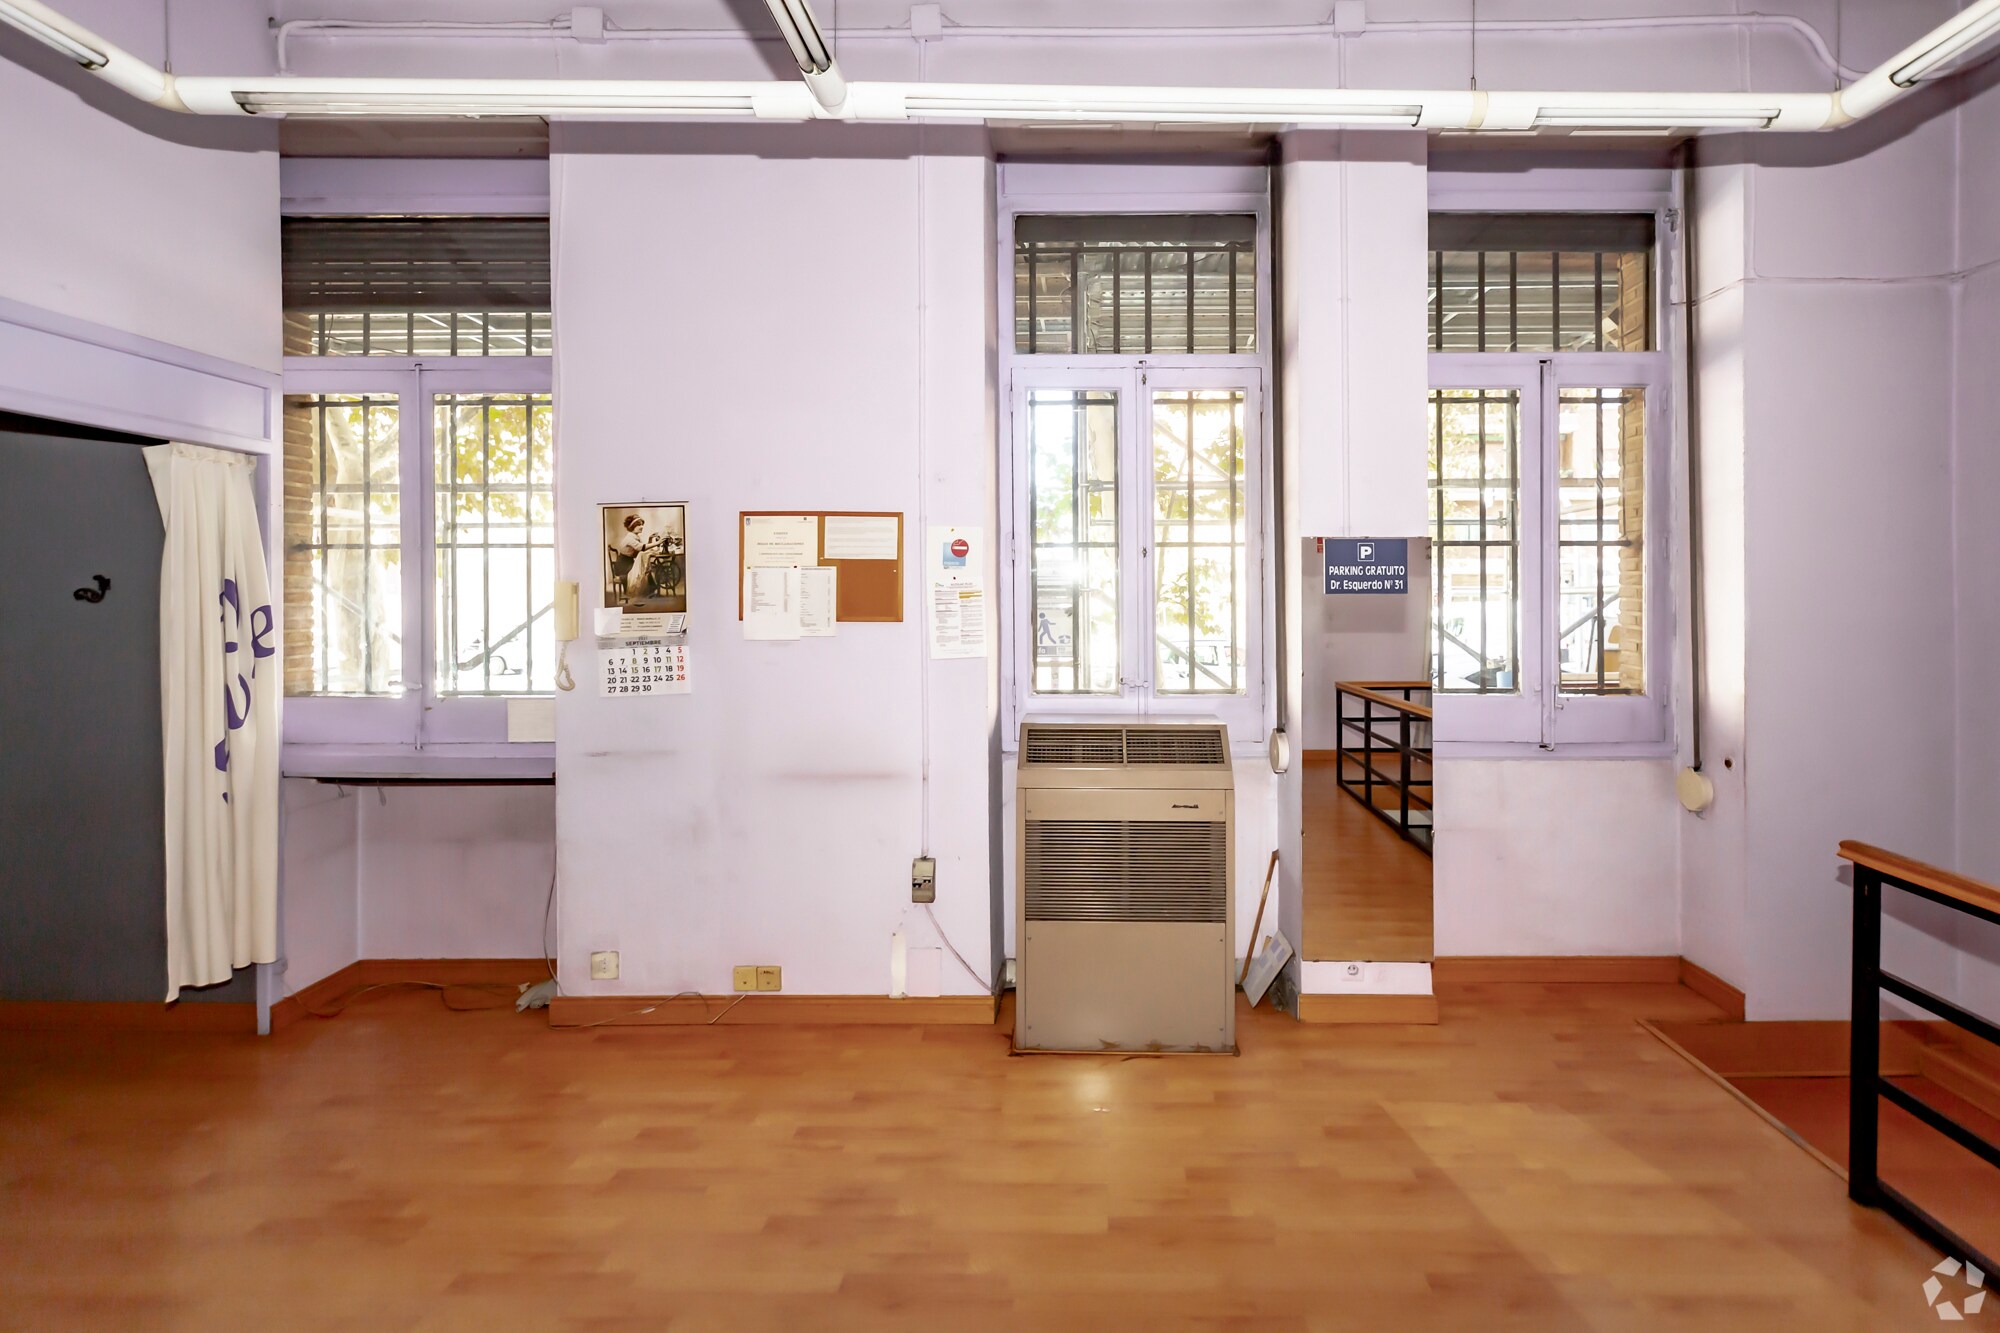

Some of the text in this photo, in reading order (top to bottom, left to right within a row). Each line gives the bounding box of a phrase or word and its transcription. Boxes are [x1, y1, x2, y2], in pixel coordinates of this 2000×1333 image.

[1360, 546, 1372, 559] P
[1328, 566, 1405, 576] PARKING GRATUITO
[1330, 580, 1342, 590] Dr.
[1343, 580, 1382, 591] Esquerdo
[1394, 580, 1403, 590] 31
